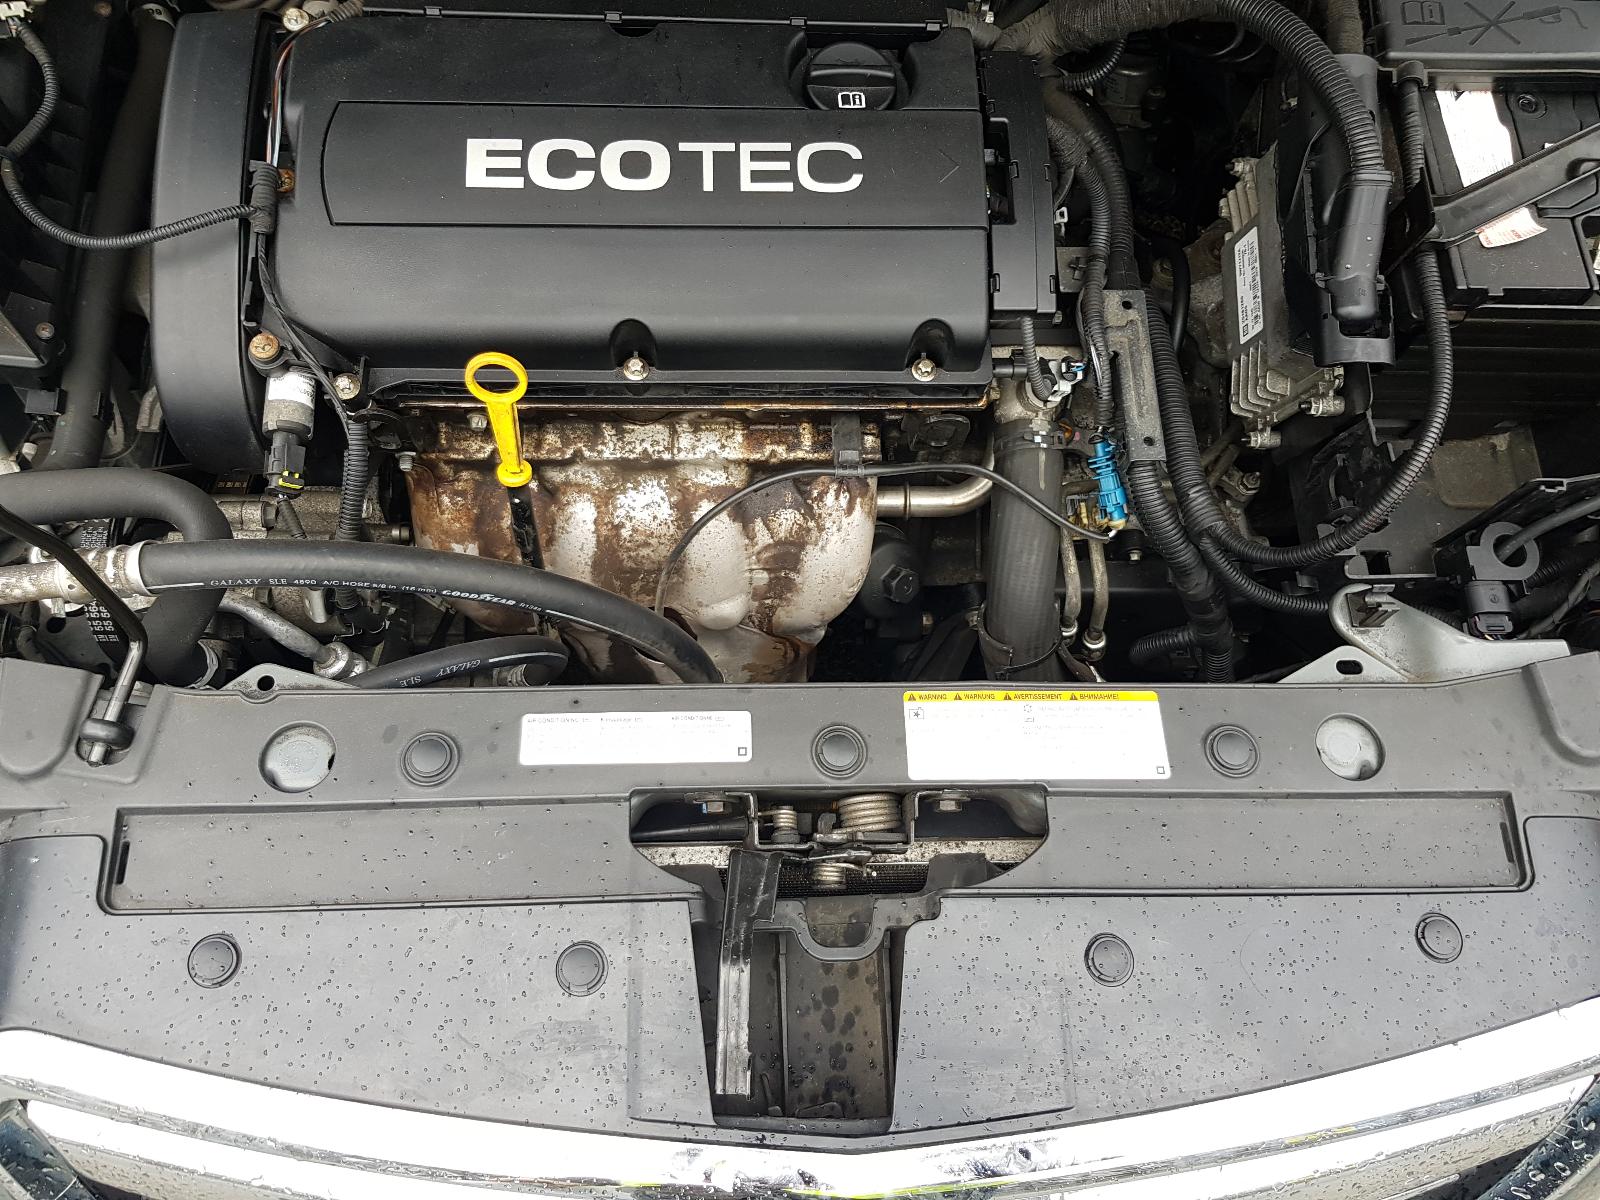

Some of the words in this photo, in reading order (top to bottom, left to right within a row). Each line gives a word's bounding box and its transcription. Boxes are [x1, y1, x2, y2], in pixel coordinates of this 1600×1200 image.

[465, 138, 864, 193] ECOTEC
[210, 578, 261, 586] GALAXY
[342, 580, 370, 588] HOSE
[442, 589, 516, 606] GOODYEAR
[92, 620, 104, 631] 55
[103, 620, 114, 631] 55
[436, 659, 481, 678] GALAXY
[400, 675, 422, 687] SLE
